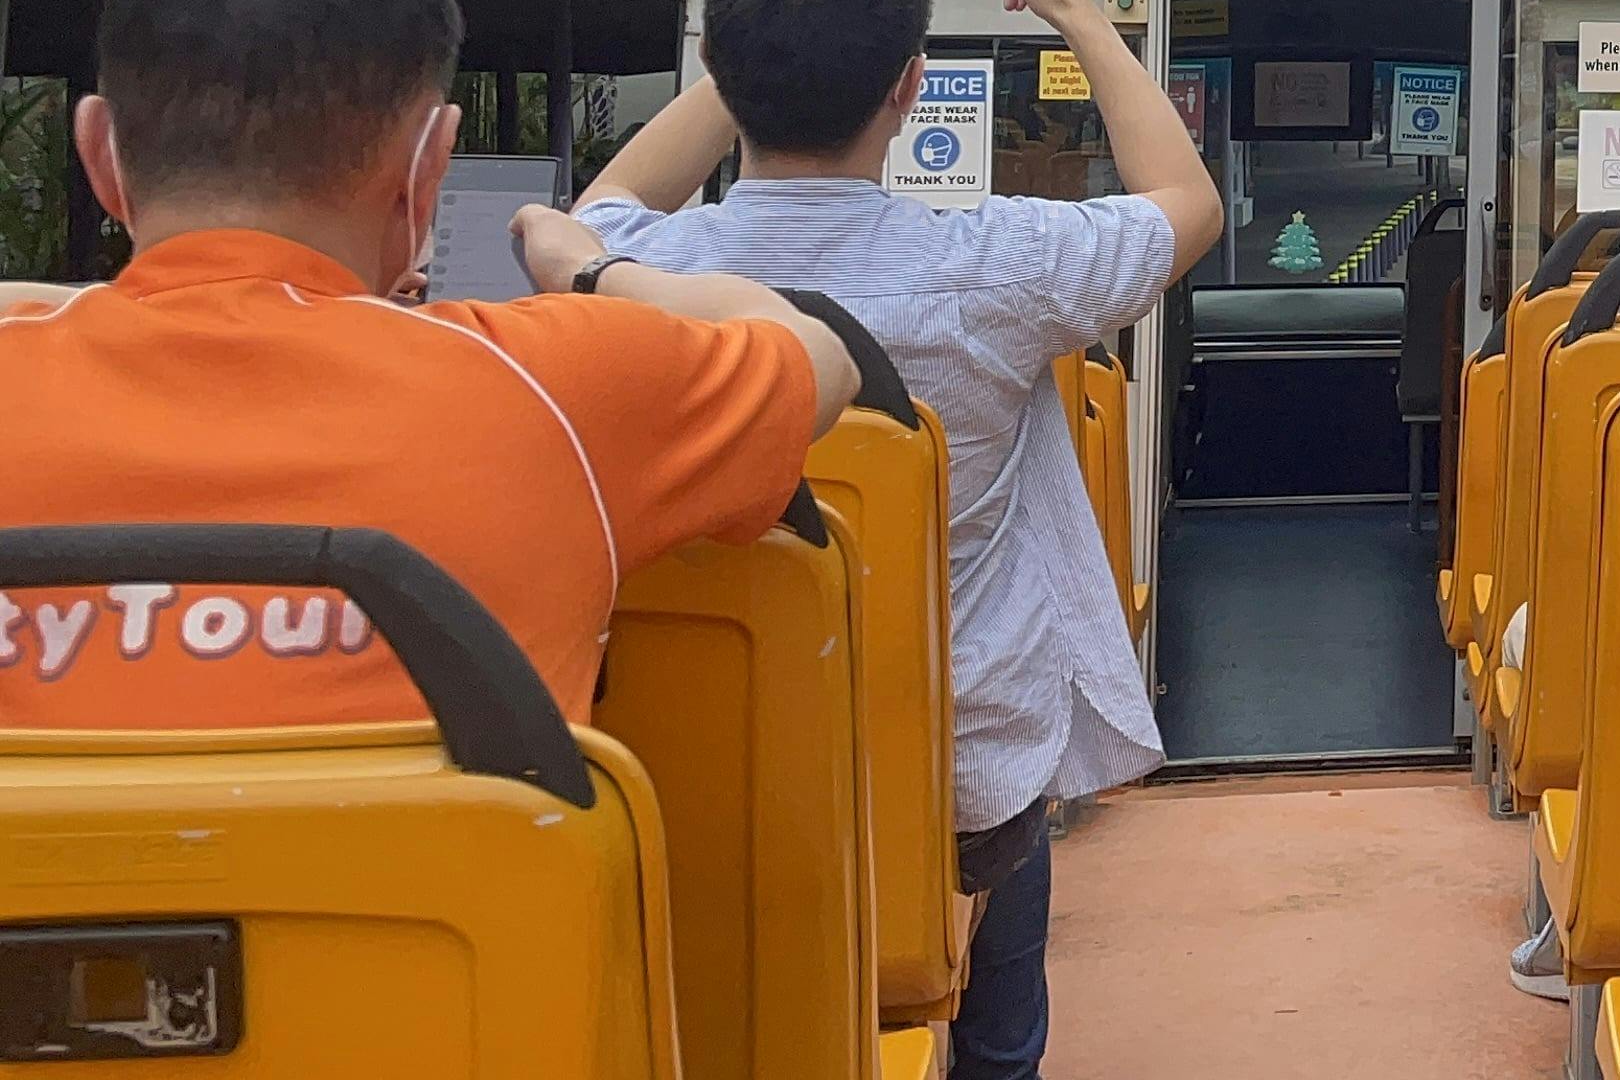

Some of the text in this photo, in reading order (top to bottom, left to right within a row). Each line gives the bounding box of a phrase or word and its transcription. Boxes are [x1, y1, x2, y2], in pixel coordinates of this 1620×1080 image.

[1585, 59, 1618, 72] when
[919, 77, 983, 95] OTICE
[1402, 77, 1454, 90] NOTICE
[911, 106, 978, 114] EASE WEAR
[911, 115, 940, 123] FACE
[944, 115, 976, 123] MASK
[895, 176, 976, 185] THANK YOU
